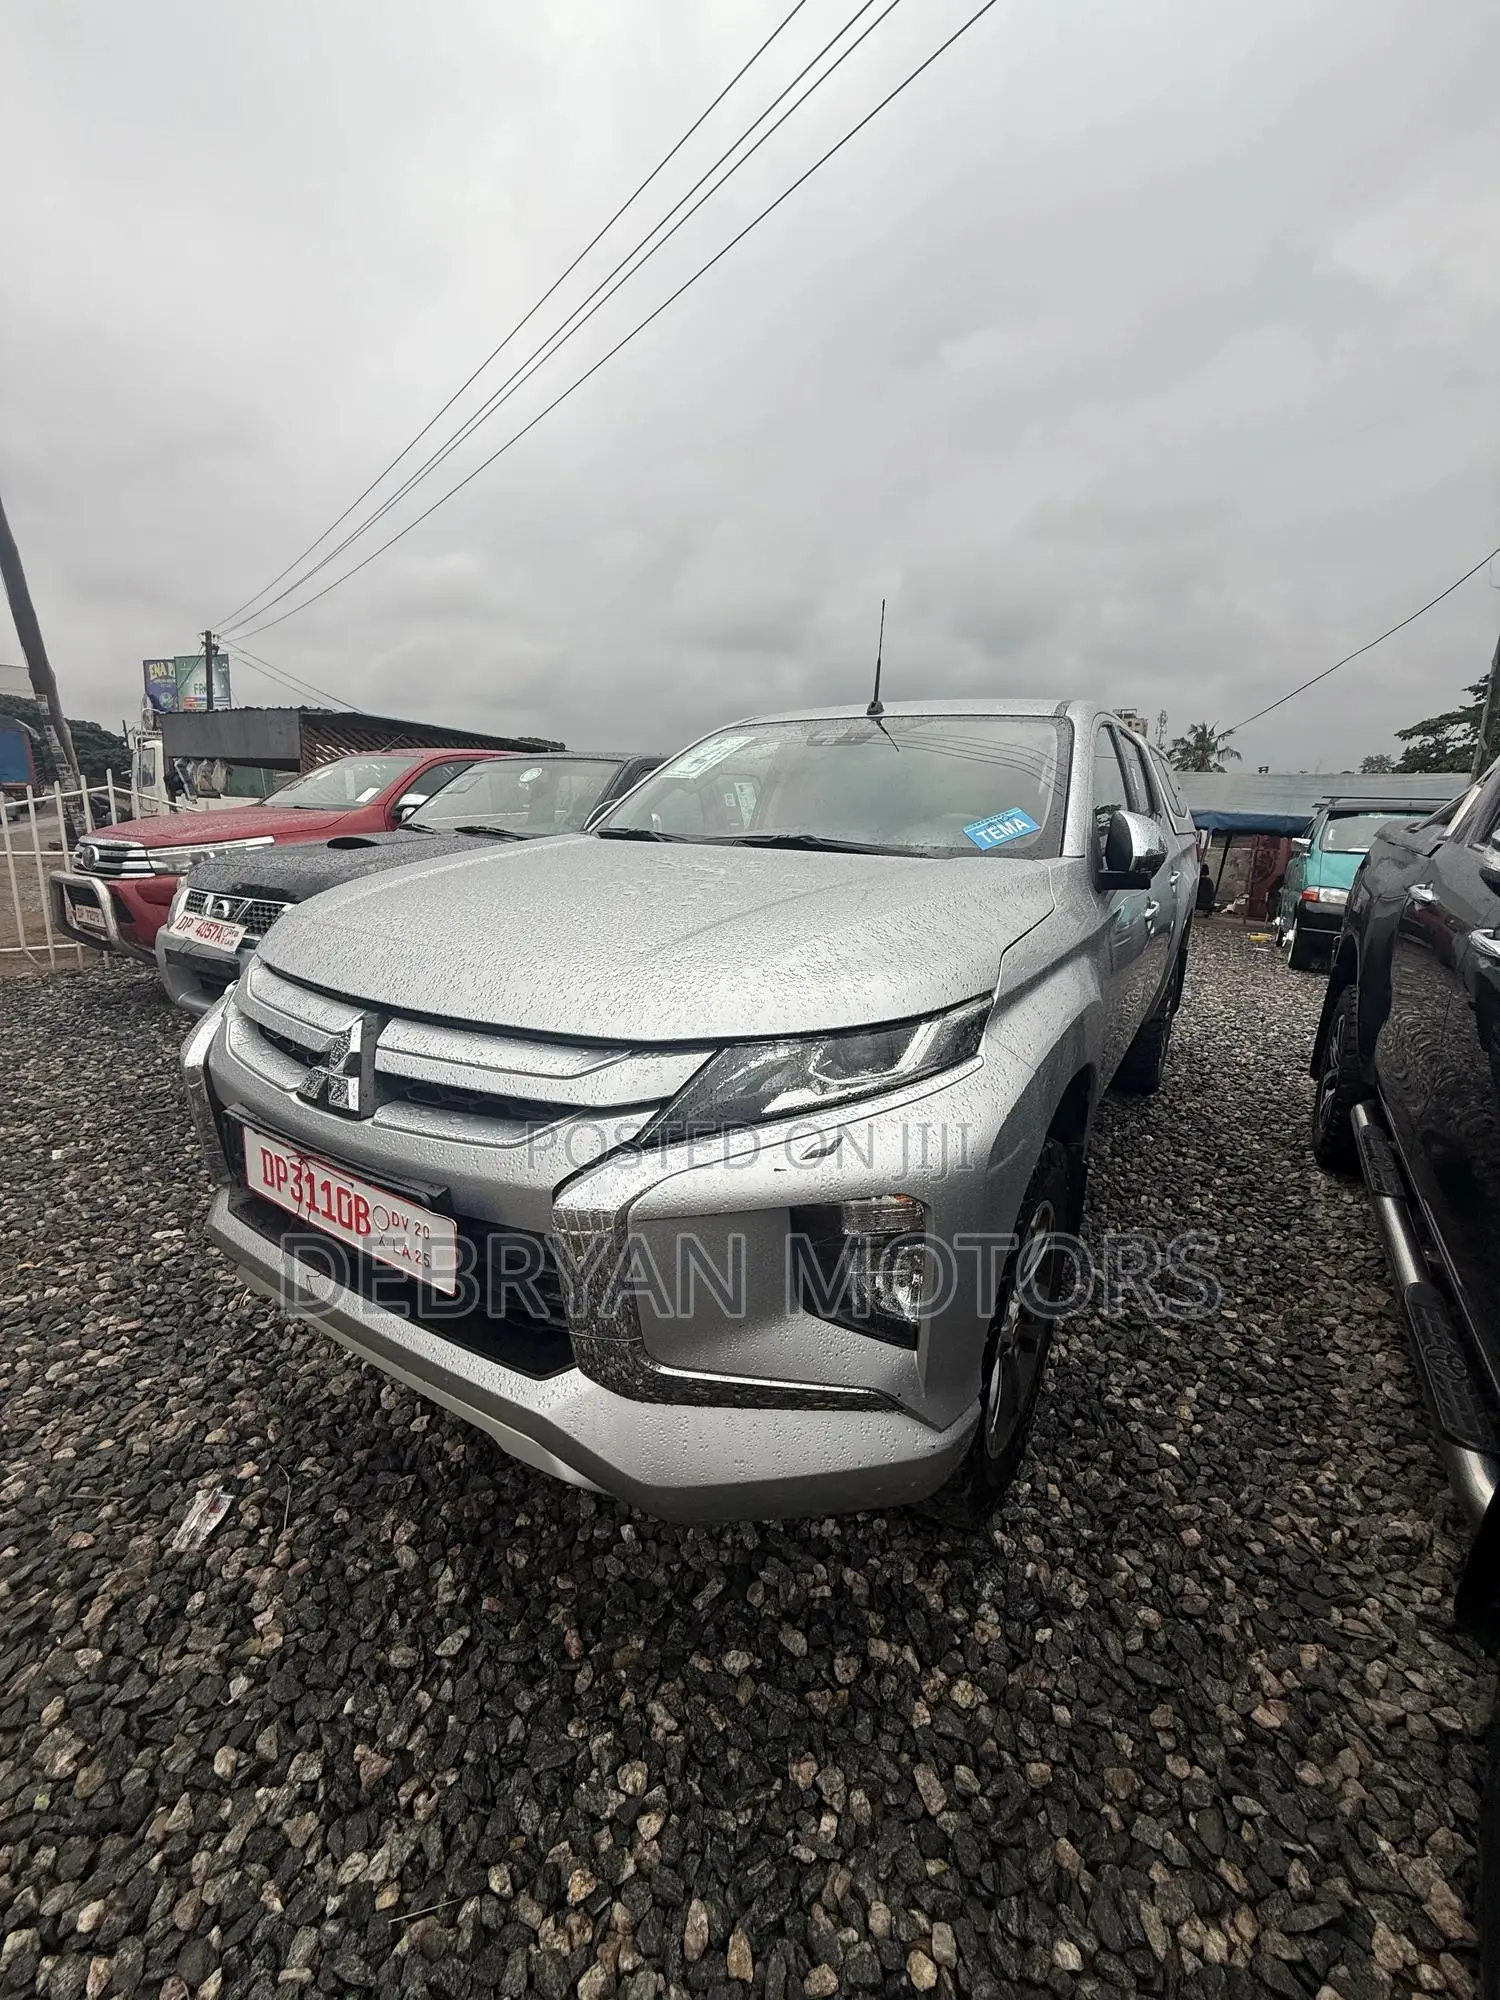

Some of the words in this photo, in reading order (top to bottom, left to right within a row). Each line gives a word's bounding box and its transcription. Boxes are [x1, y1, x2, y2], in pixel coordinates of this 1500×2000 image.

[976, 817, 1030, 843] TEMA
[175, 915, 194, 932] DP
[413, 1220, 430, 1241] 20
[391, 1237, 412, 1261] LA
[414, 1249, 432, 1269] 25
